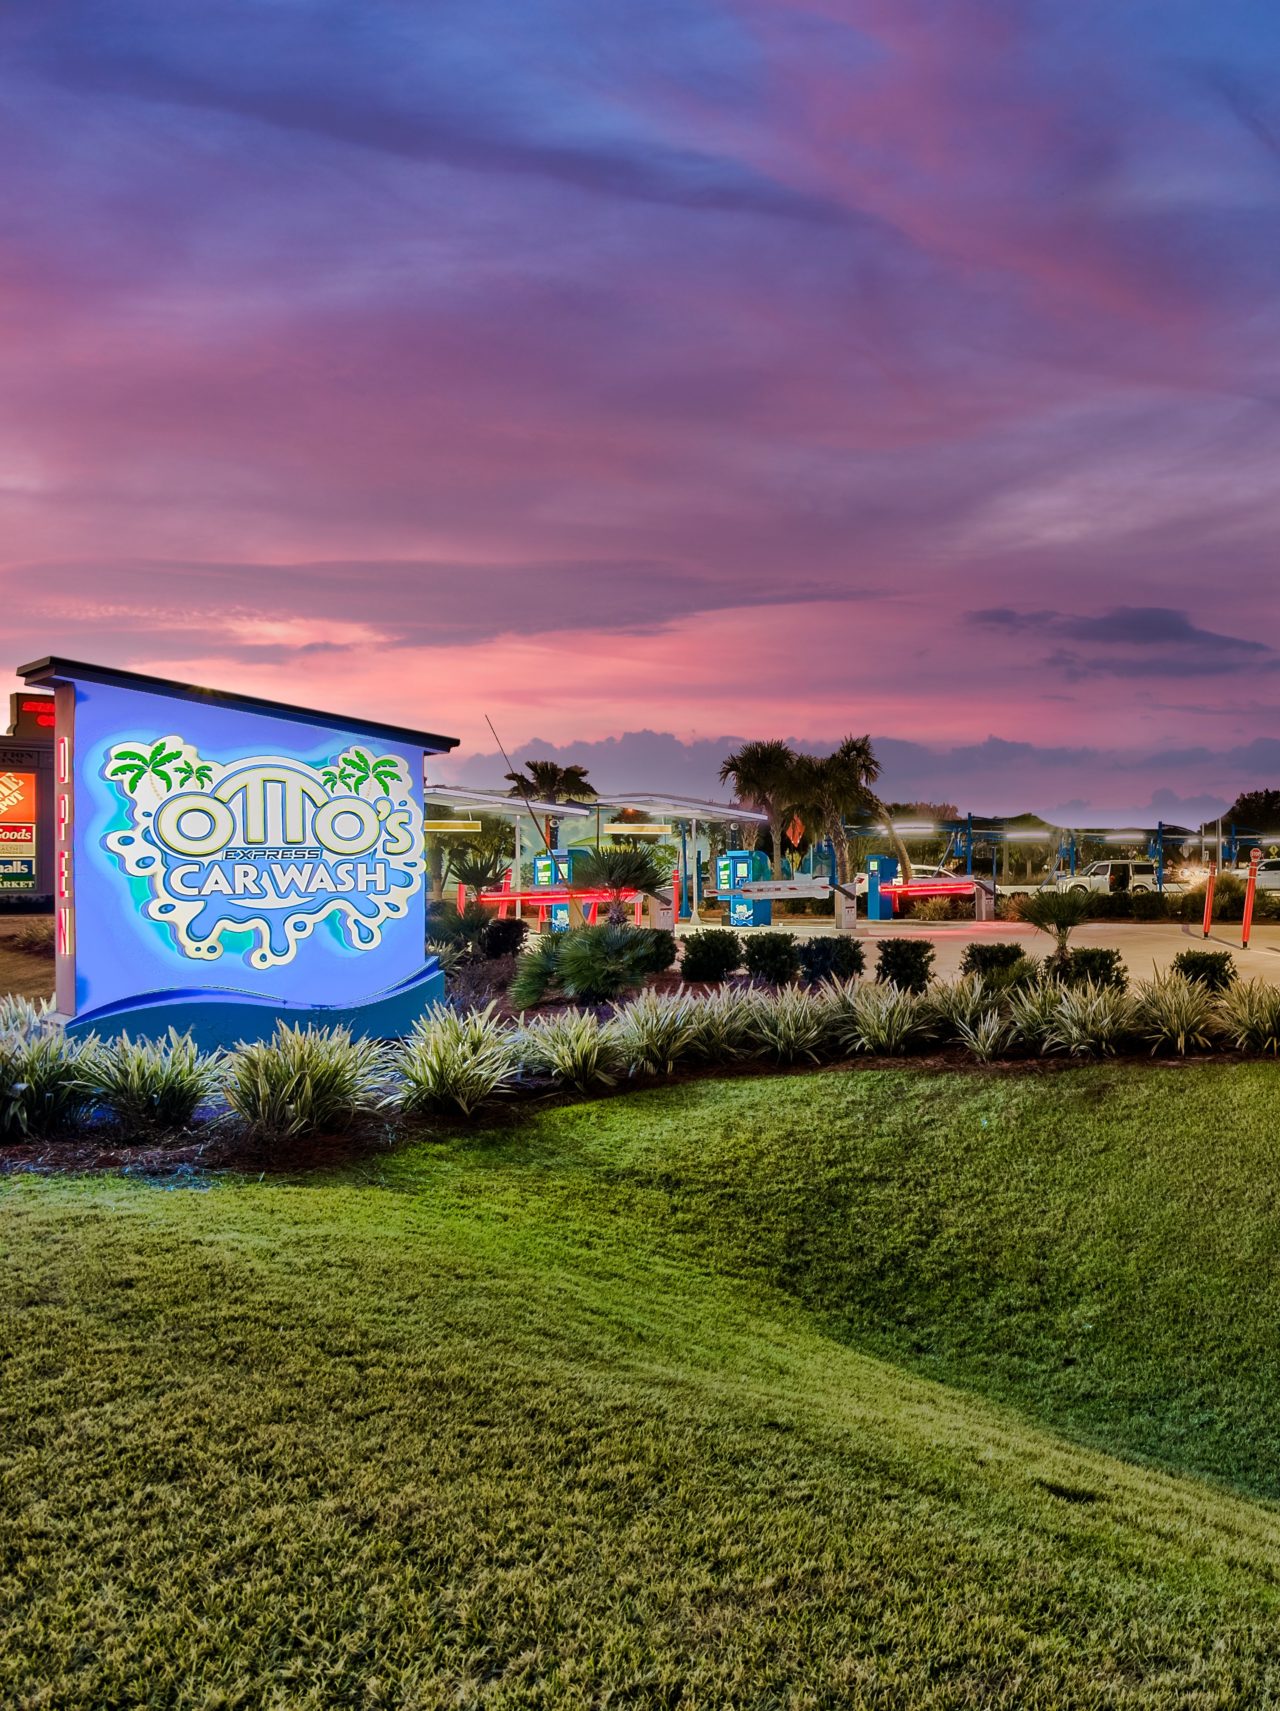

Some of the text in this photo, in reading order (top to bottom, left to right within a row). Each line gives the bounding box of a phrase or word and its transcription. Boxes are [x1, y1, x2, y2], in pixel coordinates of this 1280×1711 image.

[157, 767, 414, 856] OTTO'S
[58, 736, 69, 955] OPEN
[225, 850, 321, 861] EXPRESS
[170, 863, 387, 896] CAR WASH
